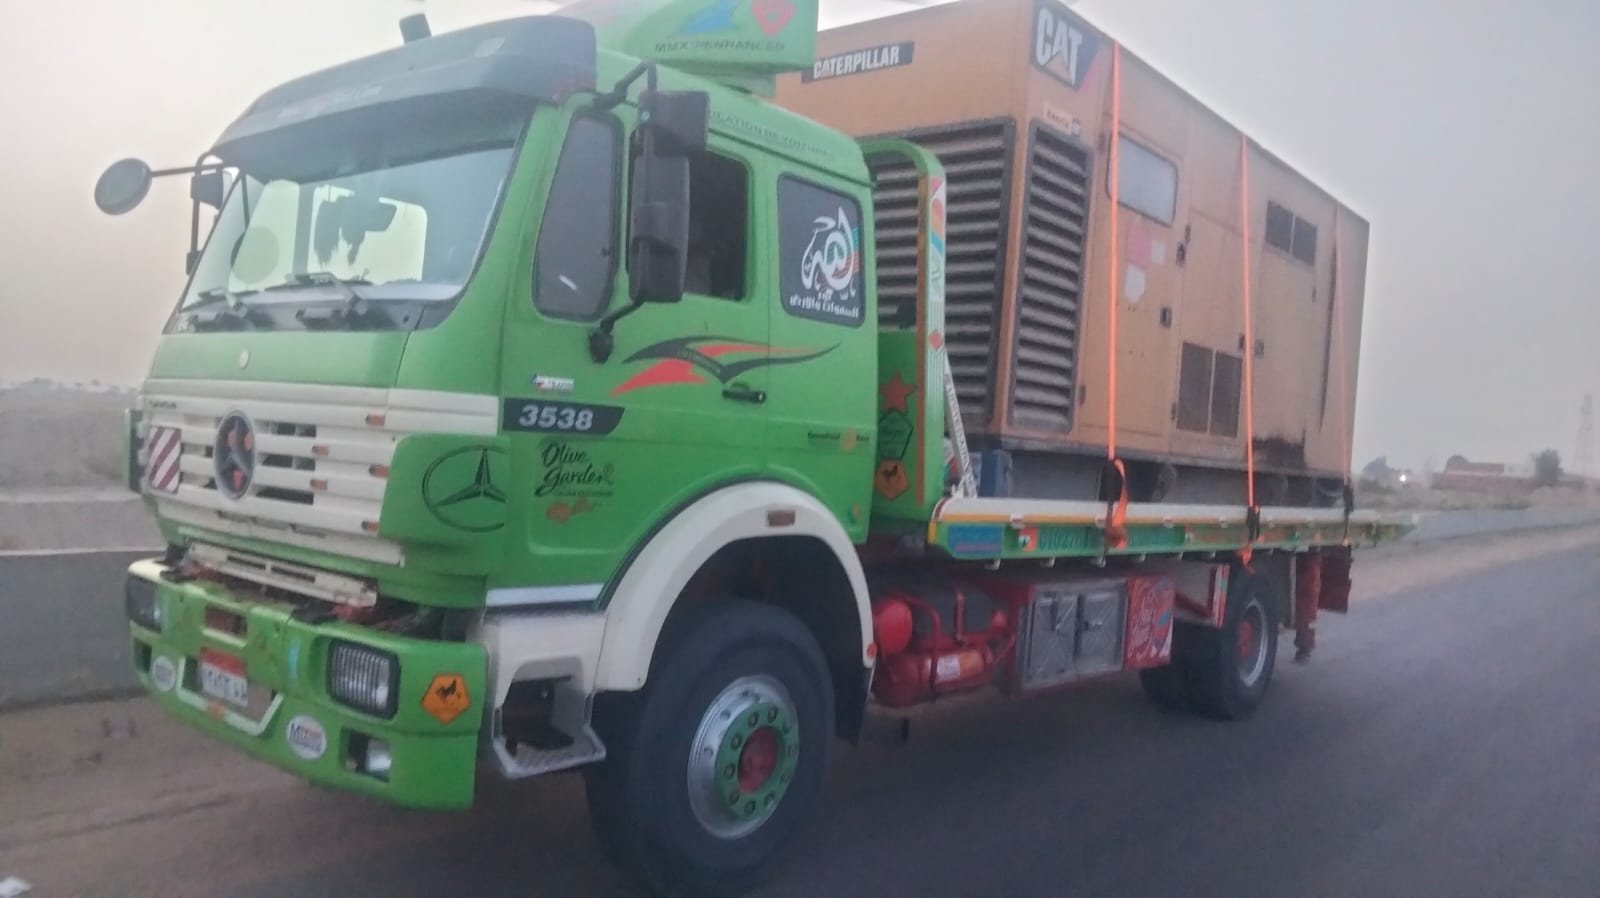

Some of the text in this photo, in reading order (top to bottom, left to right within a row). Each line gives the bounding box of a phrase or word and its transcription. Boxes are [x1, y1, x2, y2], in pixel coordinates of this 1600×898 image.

[813, 45, 900, 80] CATERPILLAR
[1036, 8, 1082, 86] CAT
[518, 404, 594, 431] 3538
